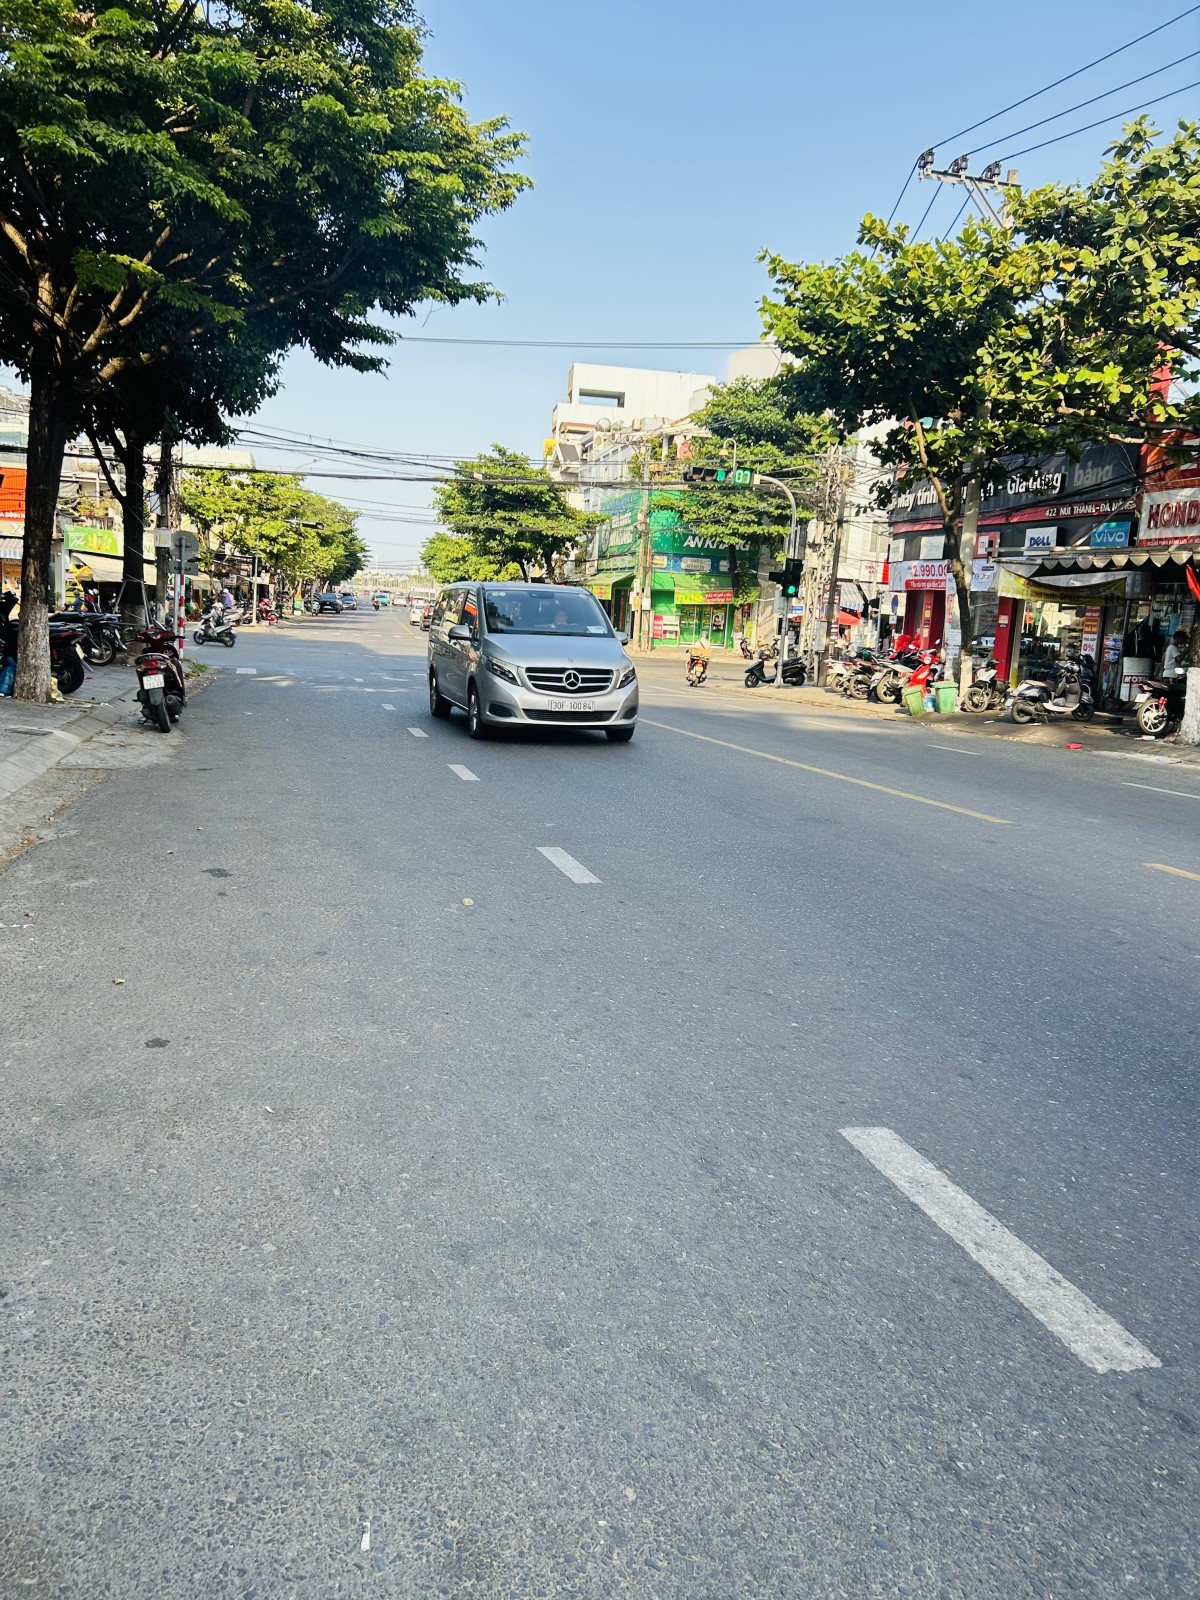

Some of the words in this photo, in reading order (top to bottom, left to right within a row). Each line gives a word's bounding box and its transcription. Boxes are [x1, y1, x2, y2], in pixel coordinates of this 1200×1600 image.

[736, 469, 751, 484] 07
[1045, 508, 1057, 517] 422
[683, 535, 704, 548] AN
[1030, 536, 1051, 547] DELL
[1095, 531, 1125, 543] vivo
[1083, 643, 1094, 652] 0%
